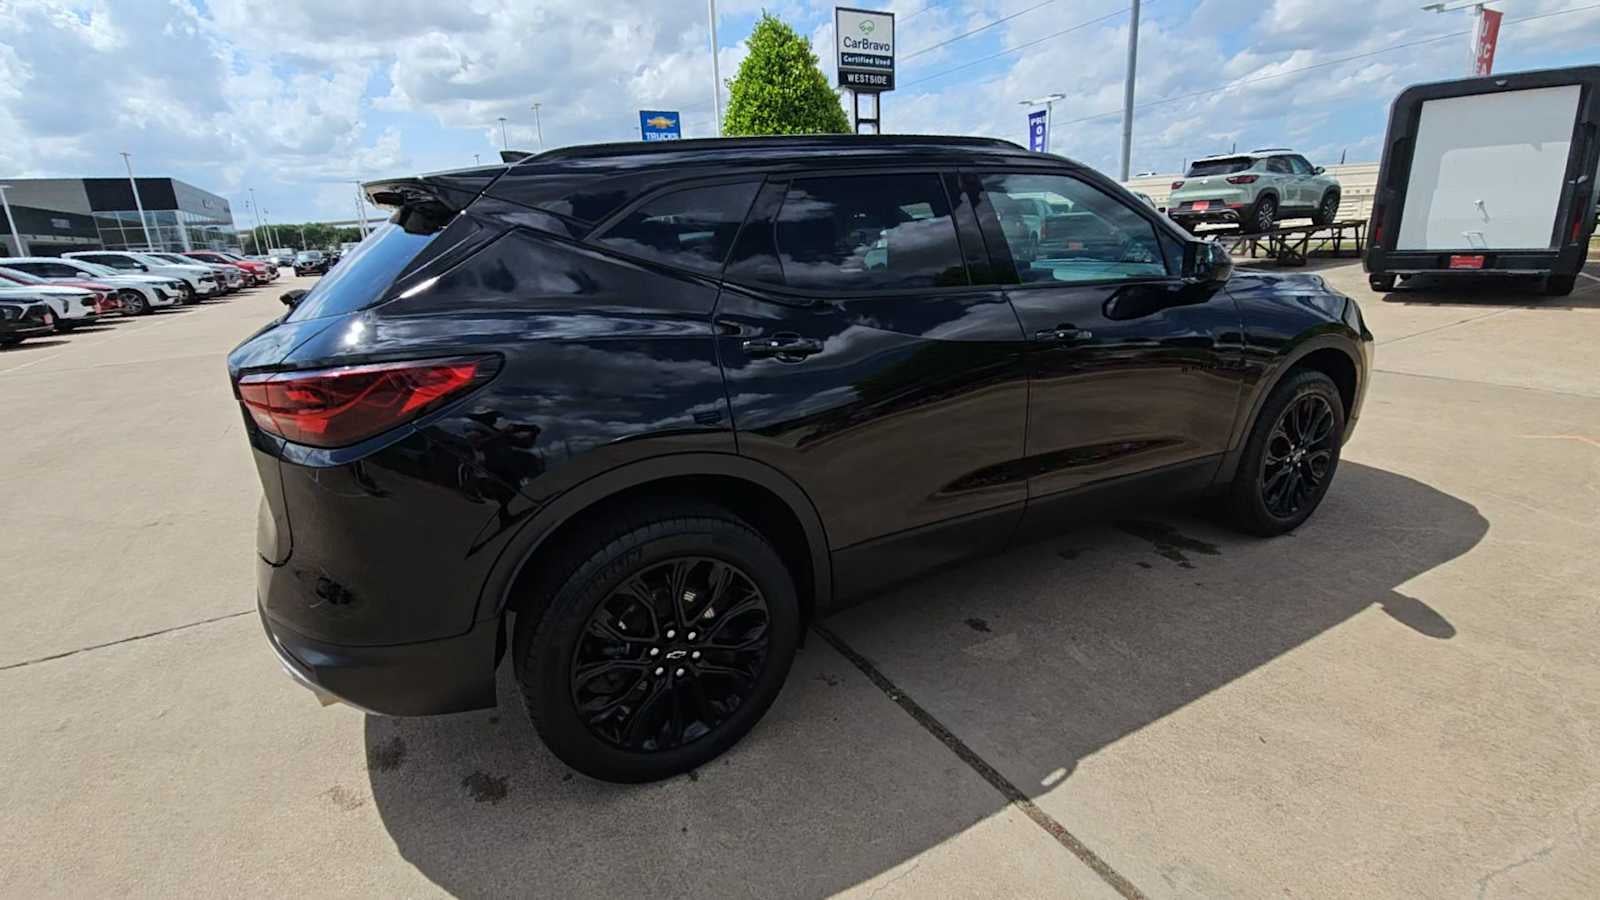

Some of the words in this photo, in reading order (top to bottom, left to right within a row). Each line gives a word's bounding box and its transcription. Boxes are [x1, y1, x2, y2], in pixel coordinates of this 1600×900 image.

[843, 36, 890, 52] CarBravo
[843, 55, 874, 65] Certified
[874, 57, 890, 66] Used
[847, 73, 888, 85] WESTSIDE
